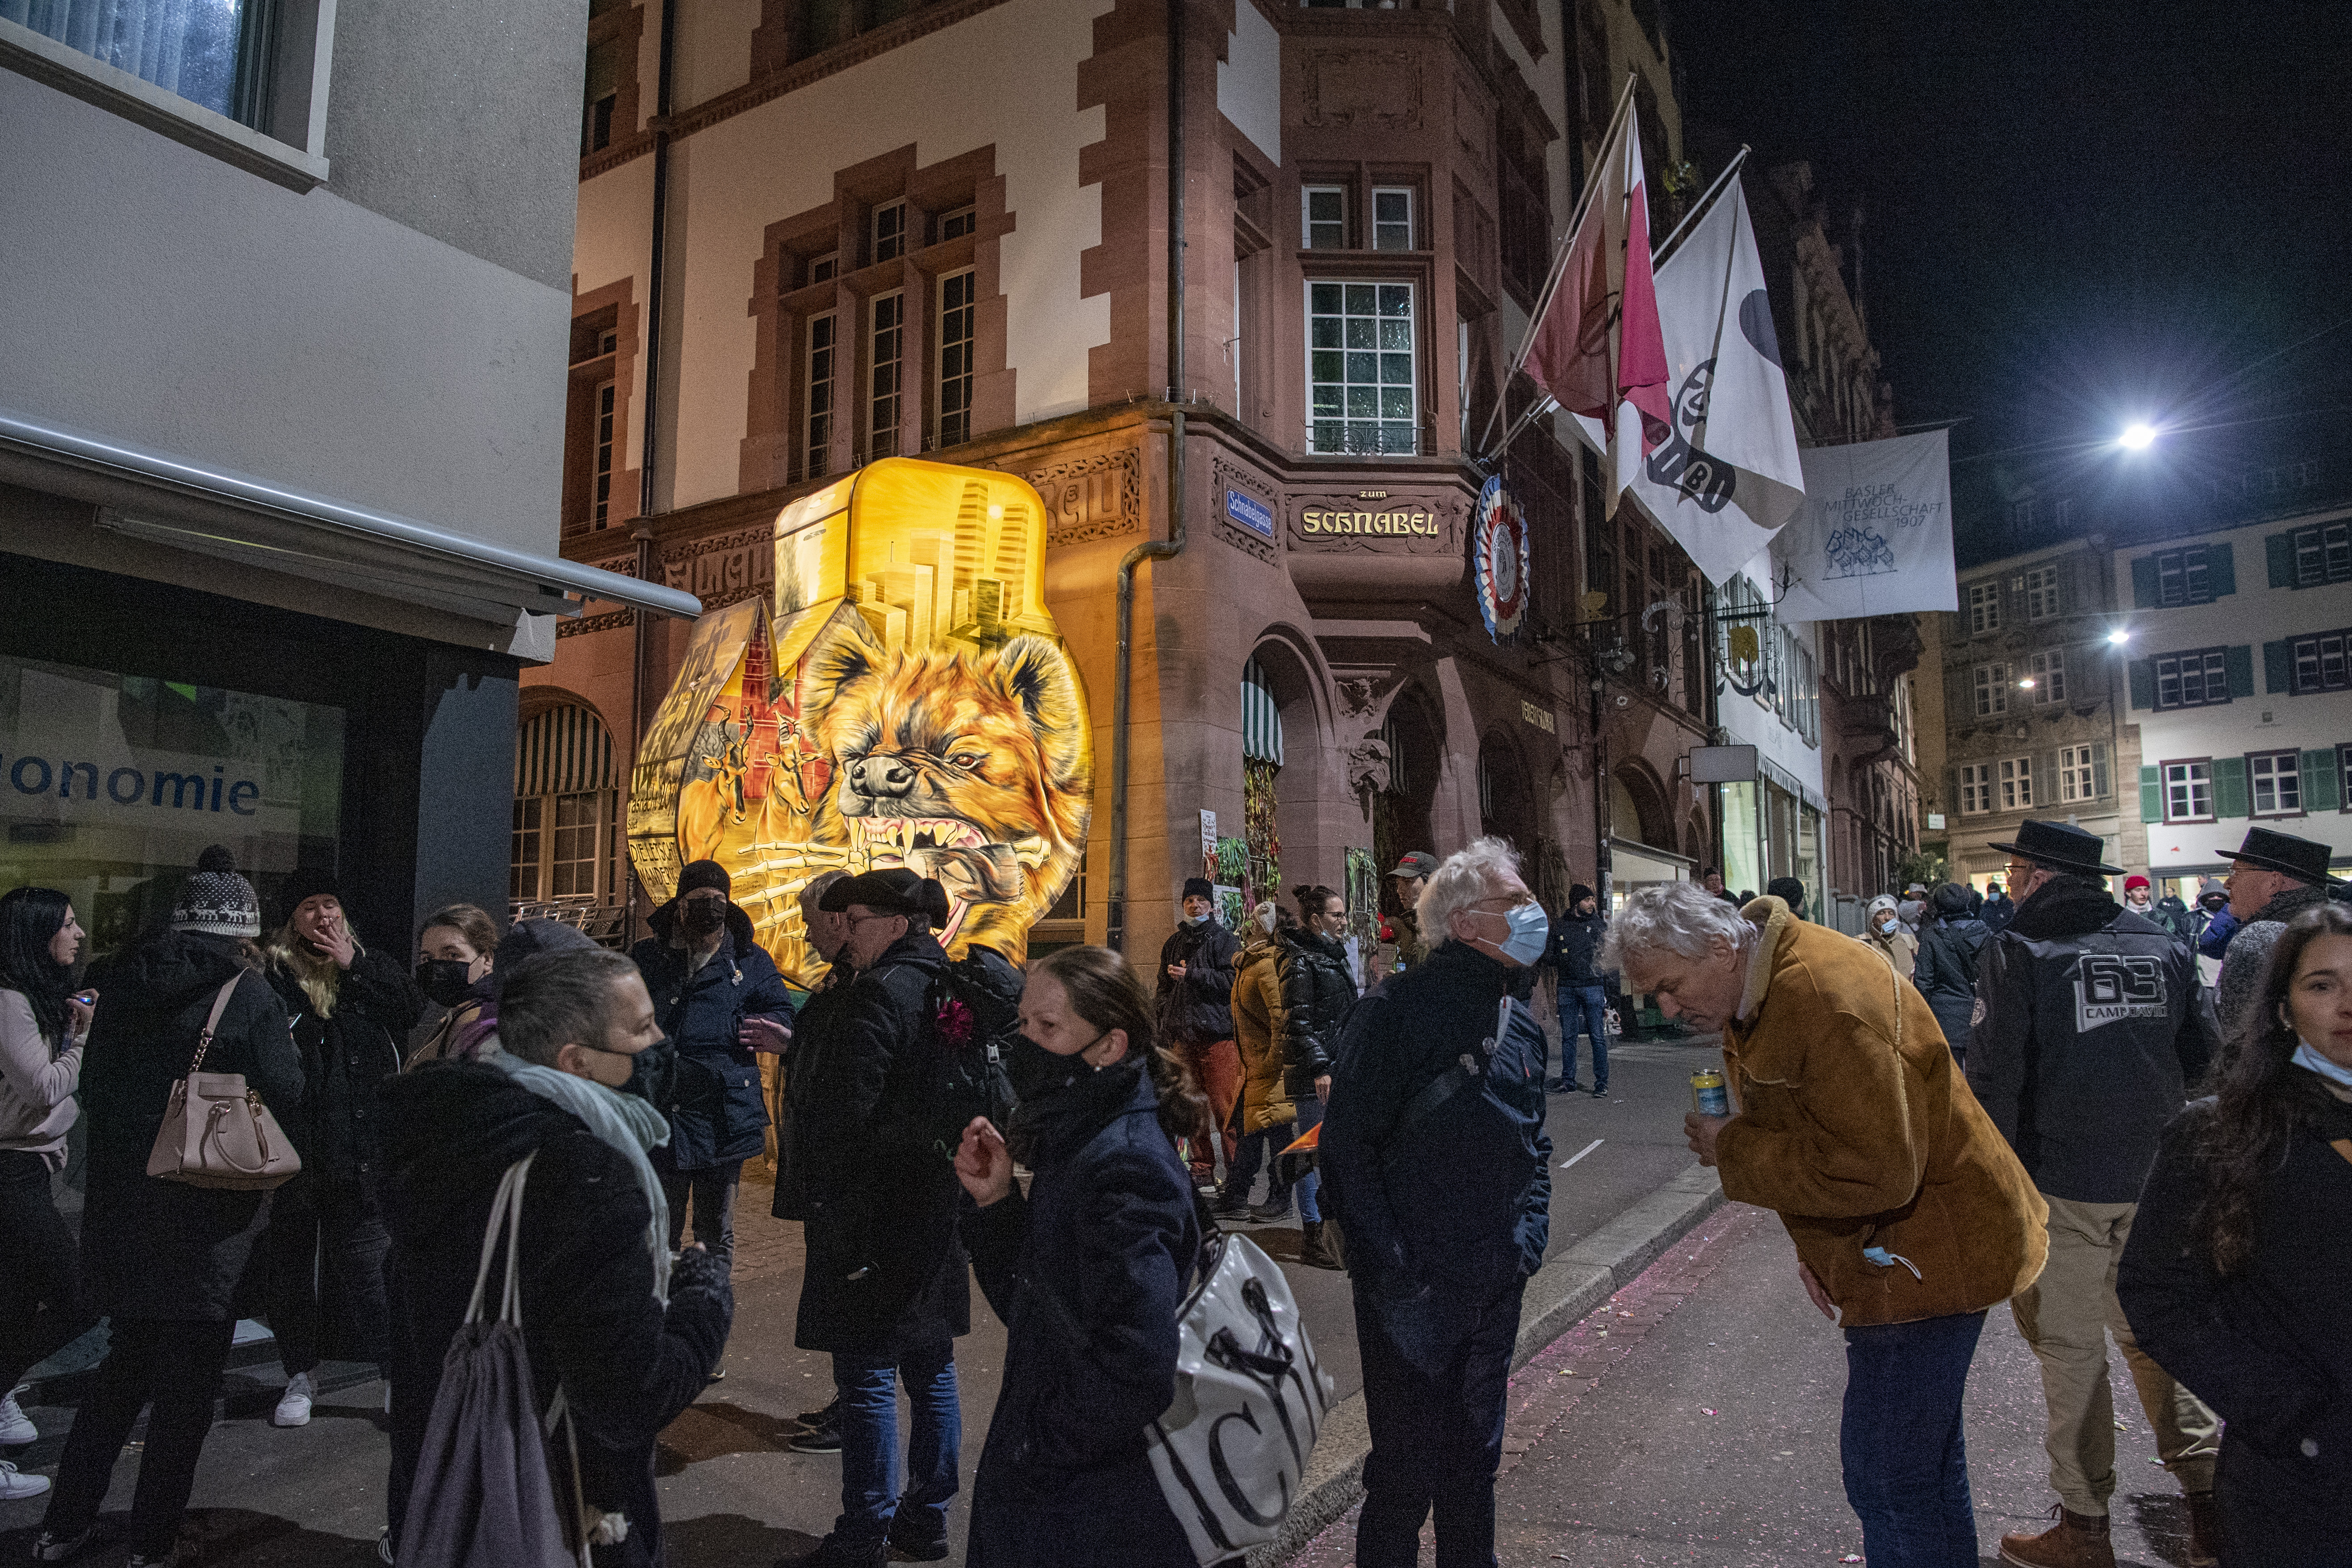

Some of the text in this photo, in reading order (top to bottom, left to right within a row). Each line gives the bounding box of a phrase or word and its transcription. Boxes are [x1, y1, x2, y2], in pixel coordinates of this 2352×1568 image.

[1360, 490, 1387, 498] zum
[1845, 484, 1895, 498] BASLER
[1230, 489, 1272, 530] Schnabelgasse
[1825, 495, 1907, 512] MITTWOCH-
[1843, 502, 1944, 522] GESELLSCHAFT
[1303, 511, 1439, 535] SCHNABEL
[1896, 515, 1926, 528] 1907
[0, 753, 259, 816] onomie
[630, 843, 648, 863] DIE
[2078, 954, 2168, 1006] 63
[2086, 1006, 2168, 1018] CAMP DAVID
